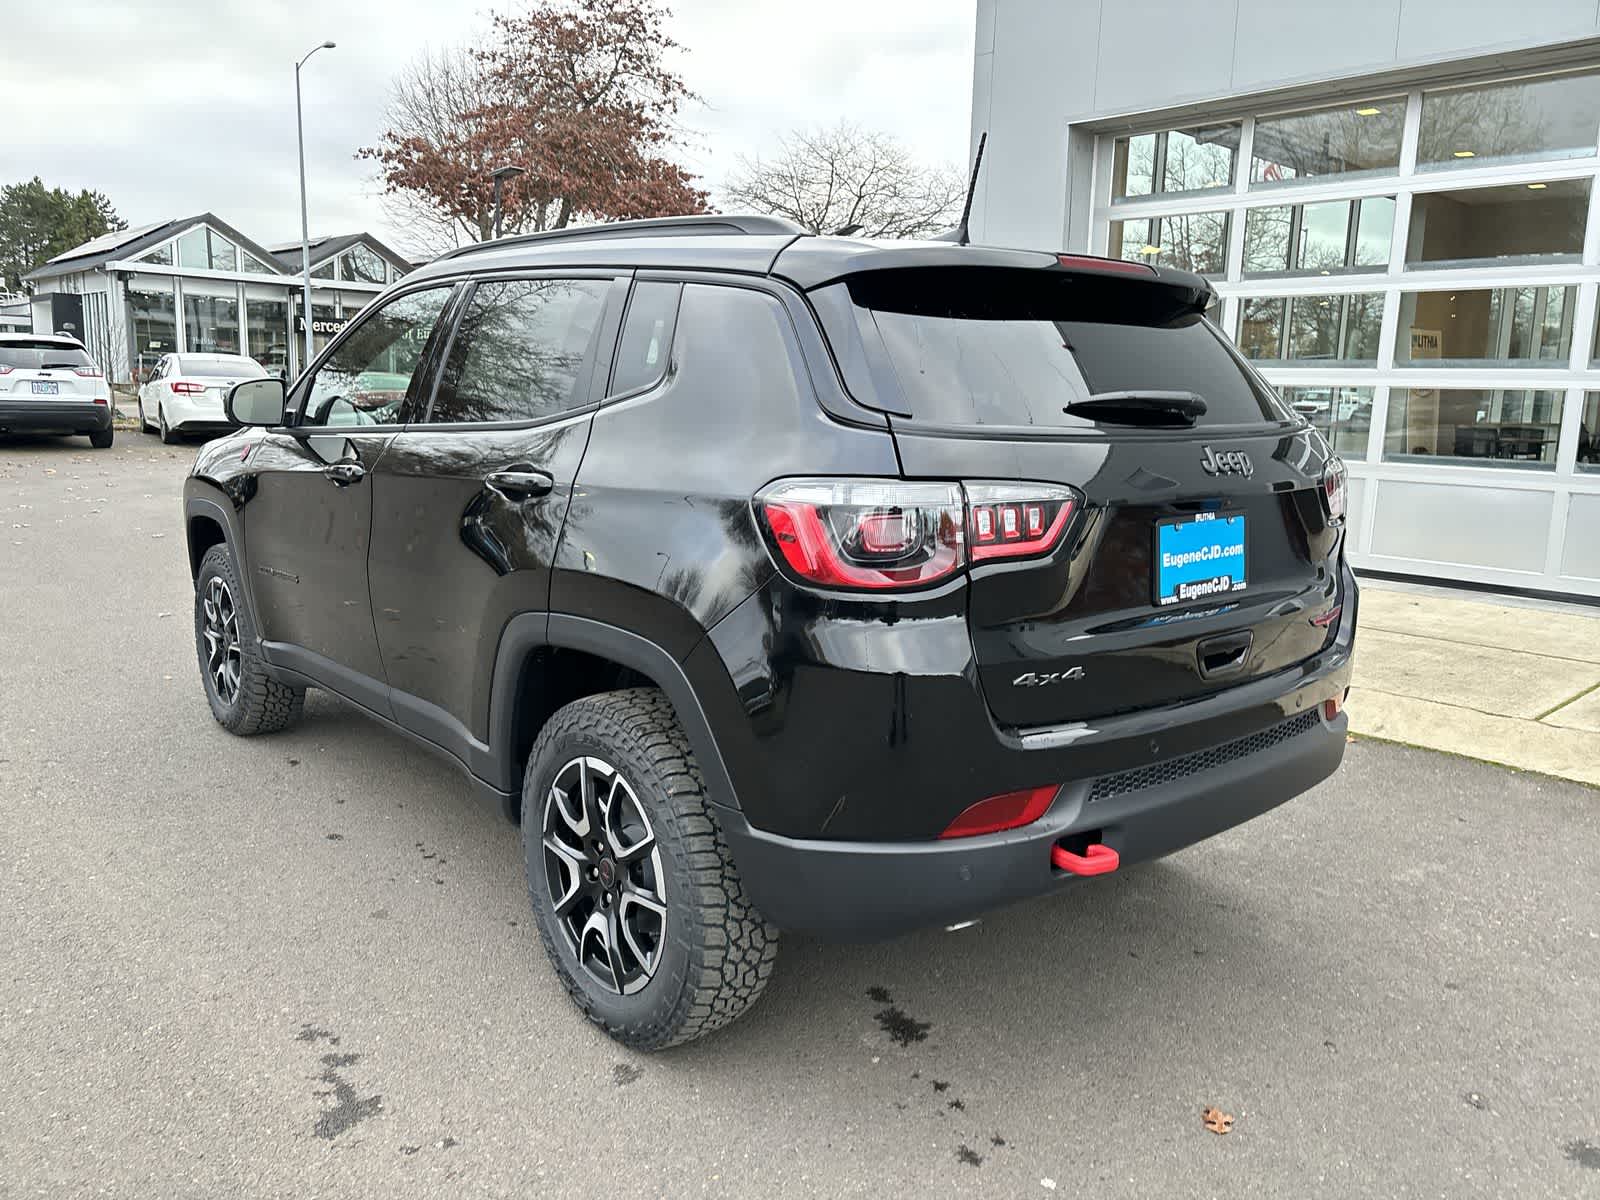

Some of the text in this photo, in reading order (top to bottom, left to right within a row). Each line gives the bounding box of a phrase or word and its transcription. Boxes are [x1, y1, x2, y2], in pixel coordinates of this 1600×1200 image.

[1201, 446, 1254, 478] Jeep
[1163, 544, 1244, 568] EugeneCJD.com
[1013, 666, 1086, 687] 4x4
